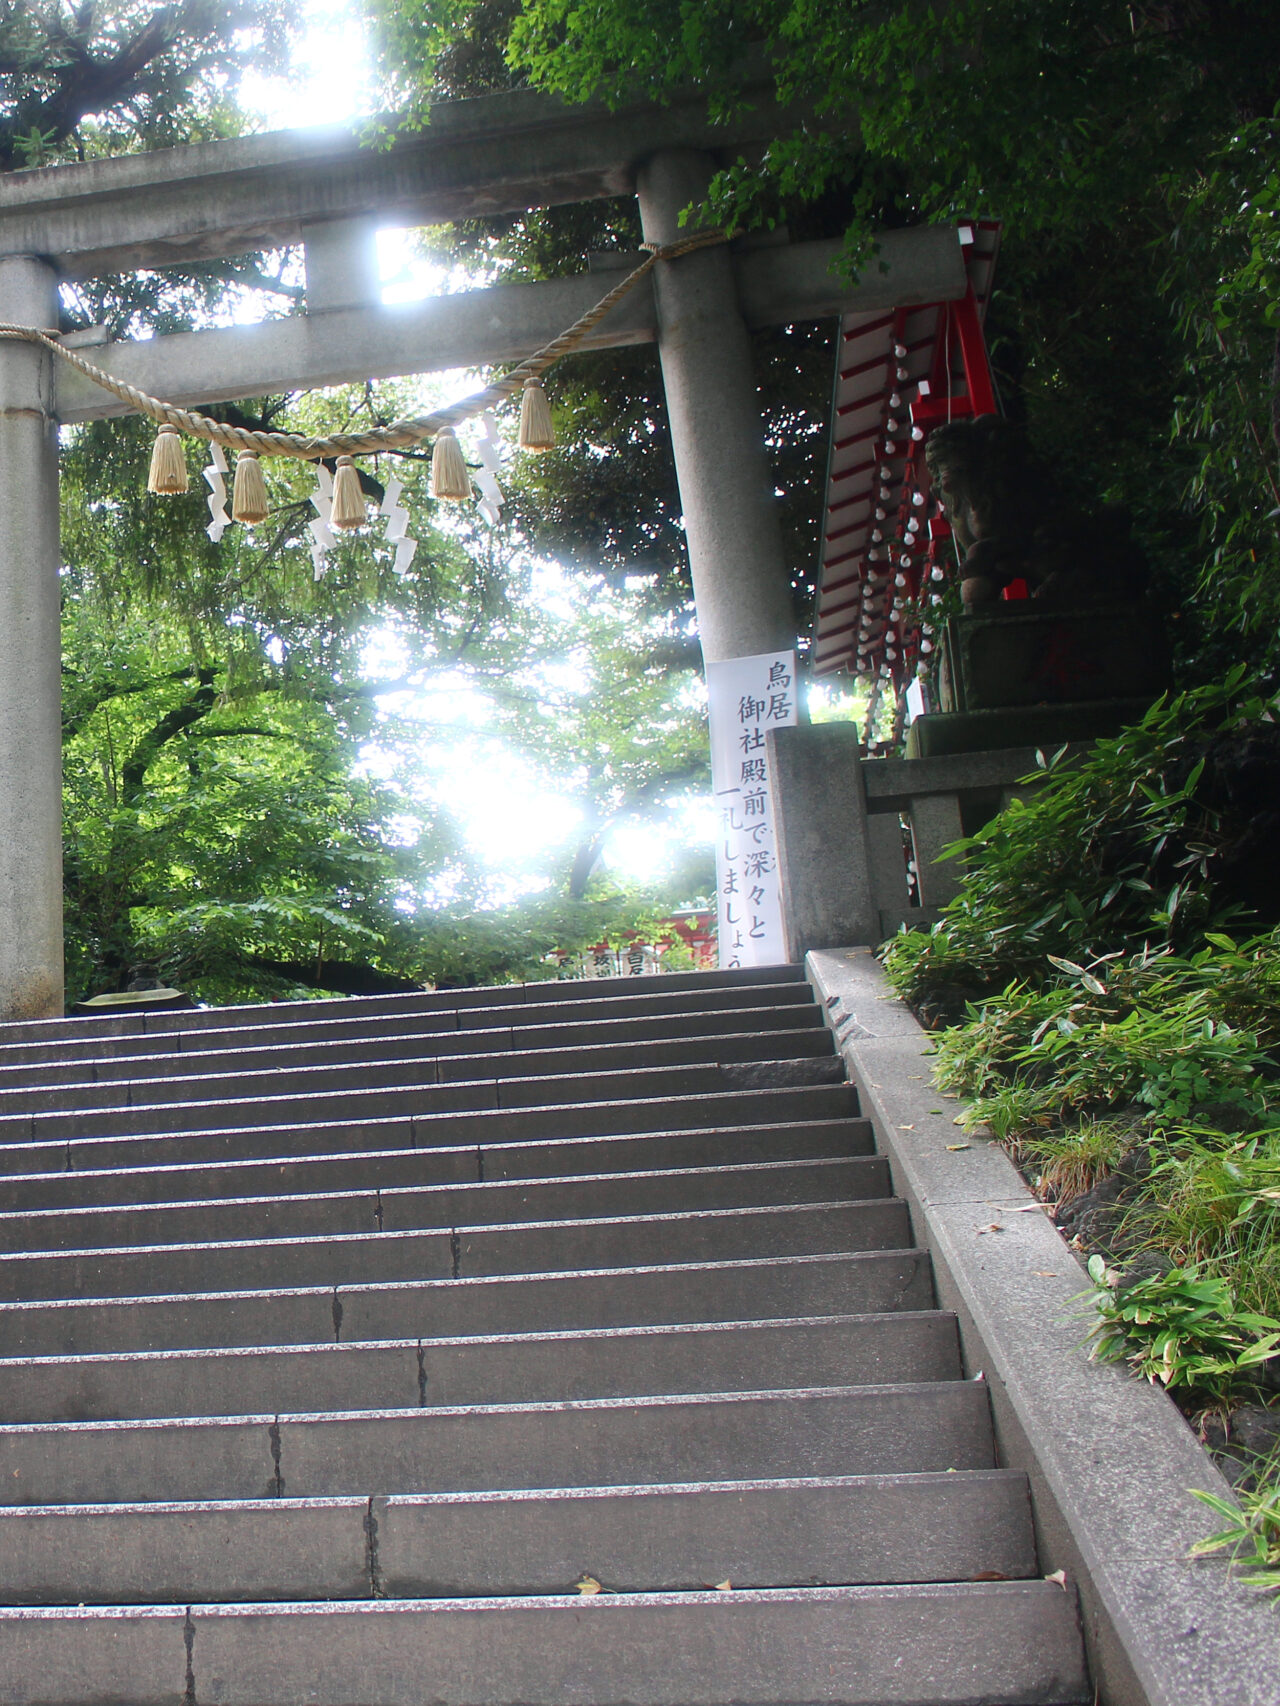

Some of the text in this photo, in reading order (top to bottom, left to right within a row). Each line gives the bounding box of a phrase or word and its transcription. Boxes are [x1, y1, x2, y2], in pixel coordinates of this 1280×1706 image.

[766, 661, 793, 721] 鳥居
[715, 787, 745, 969] 一礼しましょう
[738, 695, 773, 939] 御社殿前で深々と
